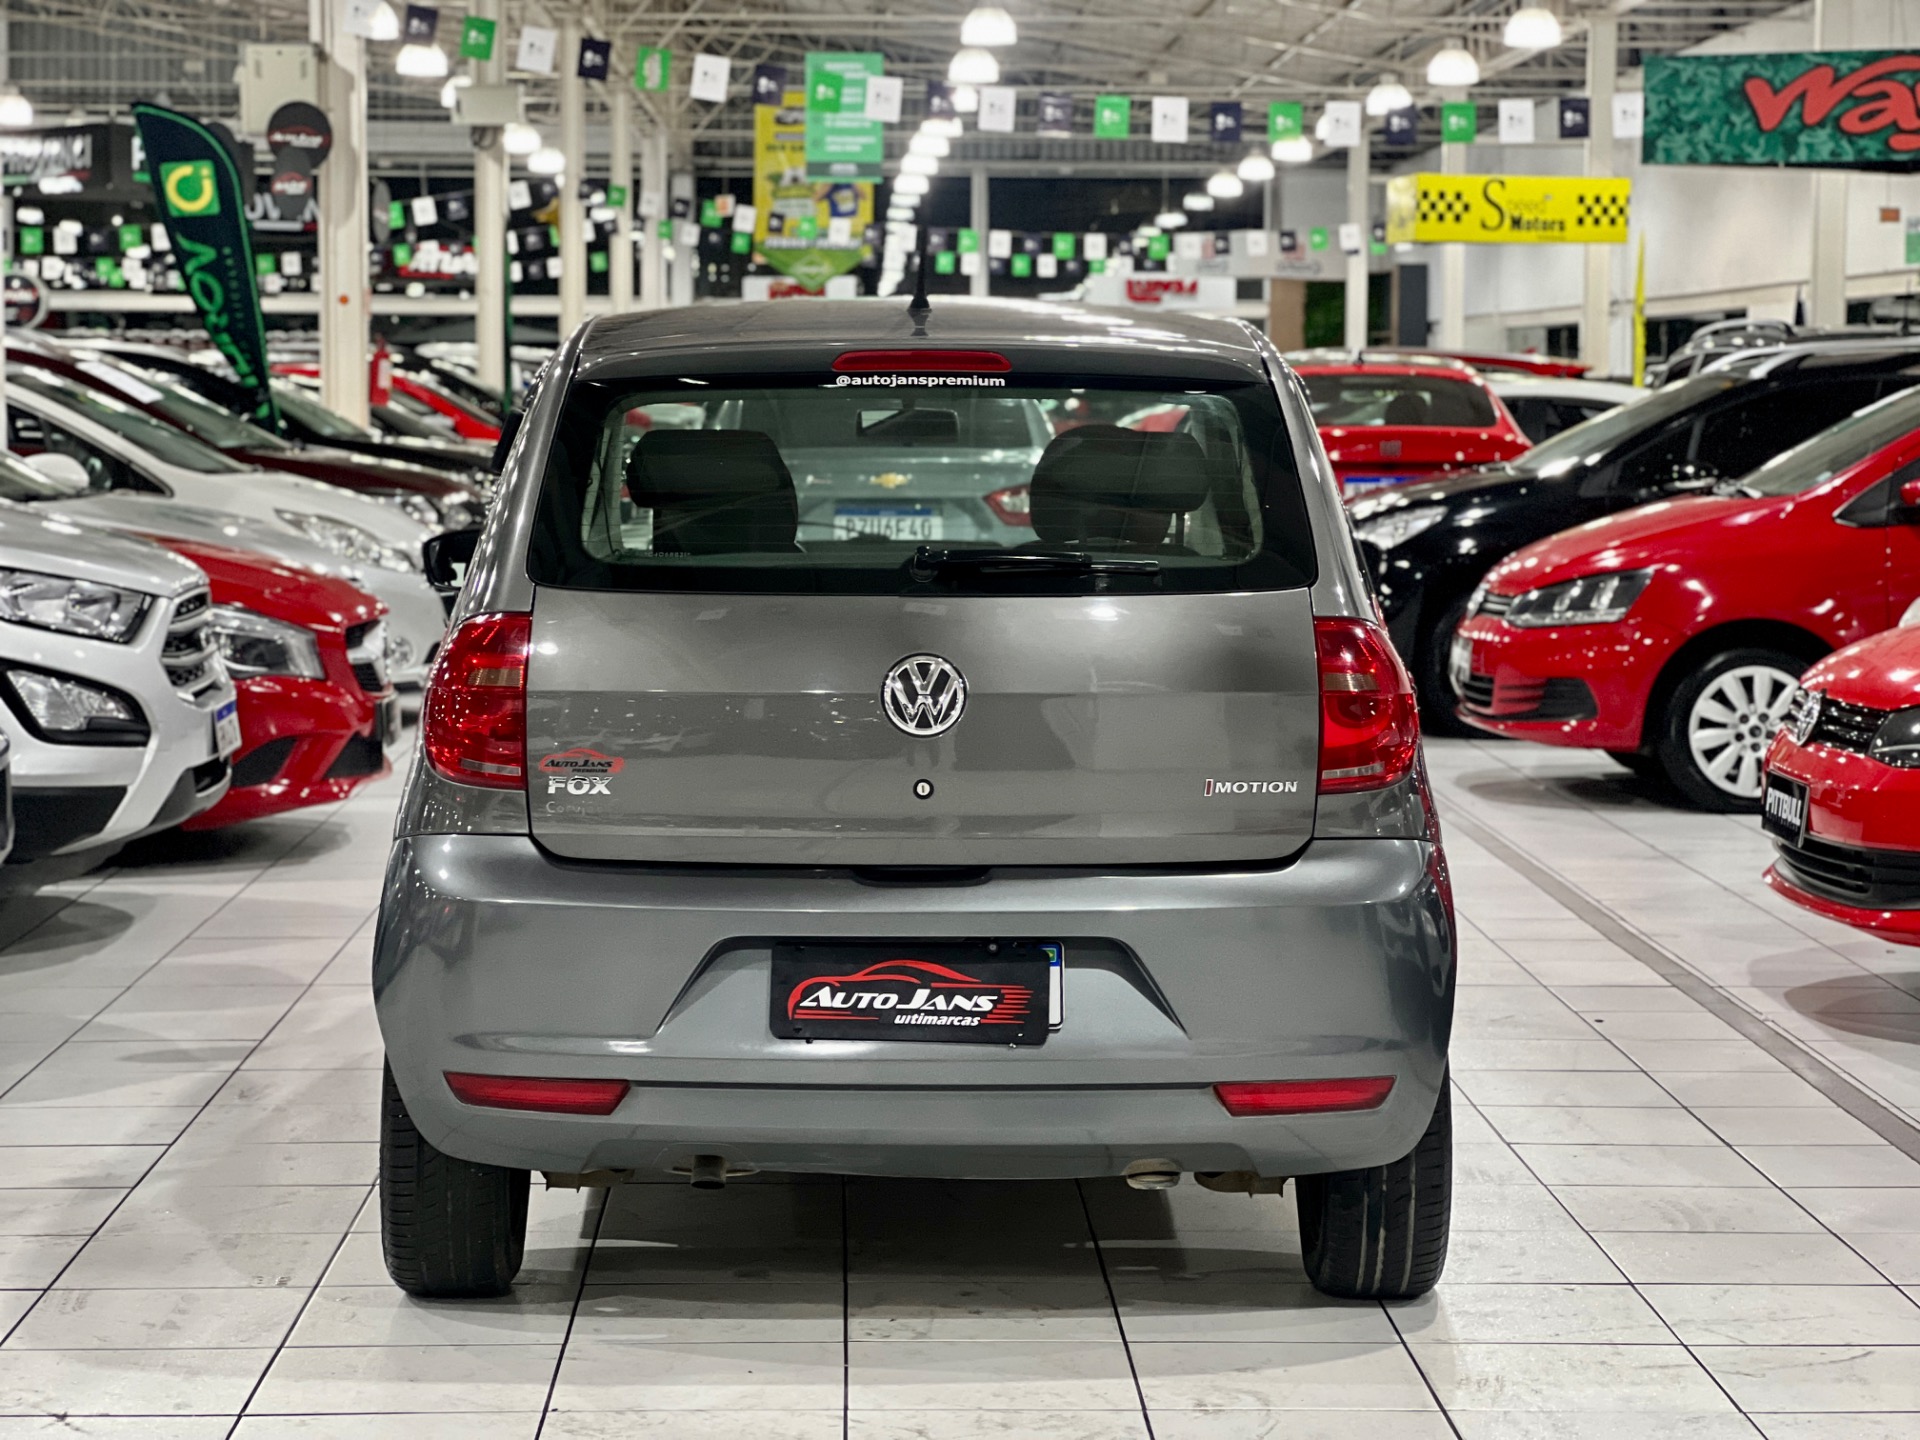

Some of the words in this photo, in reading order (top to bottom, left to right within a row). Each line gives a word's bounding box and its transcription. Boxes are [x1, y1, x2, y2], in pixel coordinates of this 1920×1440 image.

[836, 375, 1006, 387] @autojanspremium
[884, 656, 964, 735] VW
[547, 775, 613, 795] FOX
[1765, 787, 1802, 826] PITTBULL
